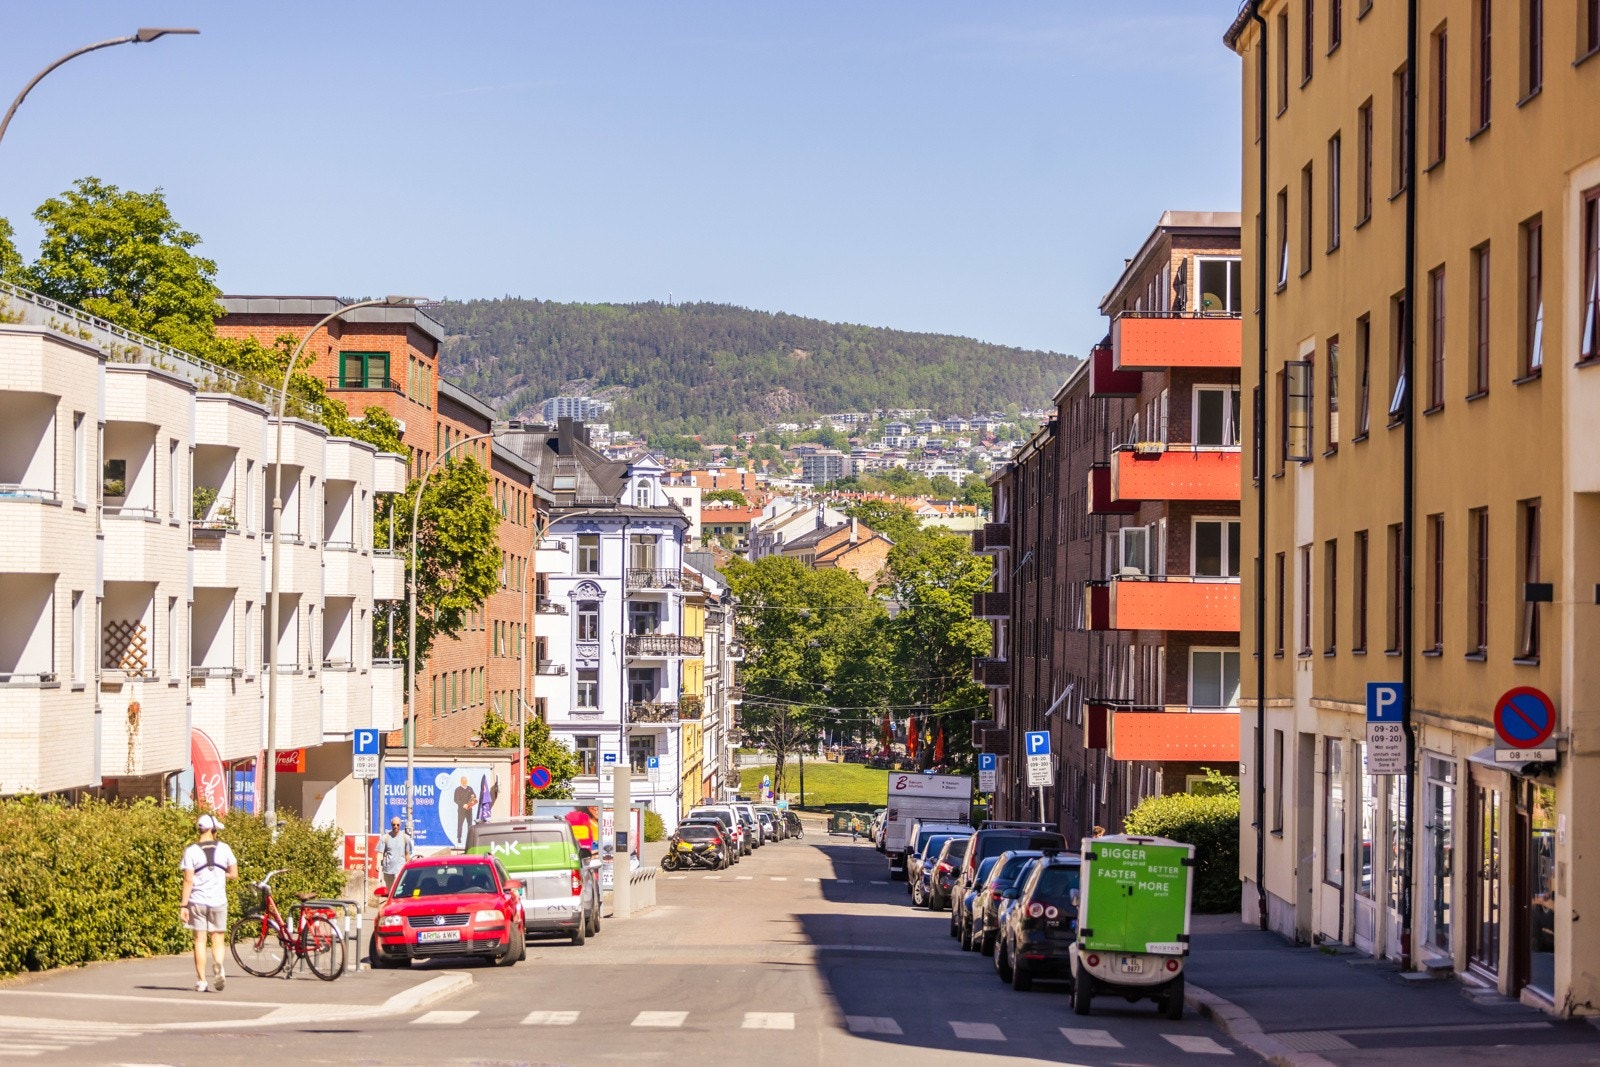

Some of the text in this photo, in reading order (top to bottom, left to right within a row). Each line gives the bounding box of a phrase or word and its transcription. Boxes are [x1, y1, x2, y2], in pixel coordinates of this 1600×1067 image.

[1376, 687, 1397, 717] P
[360, 731, 373, 752] P
[1031, 734, 1044, 753] P
[275, 751, 299, 765] fresh
[650, 758, 657, 767] P
[982, 755, 992, 769] P
[1101, 847, 1146, 860] BIGGER
[1097, 868, 1136, 879] FASTER
[1147, 866, 1179, 874] BETTER
[1138, 881, 1169, 891] MORE
